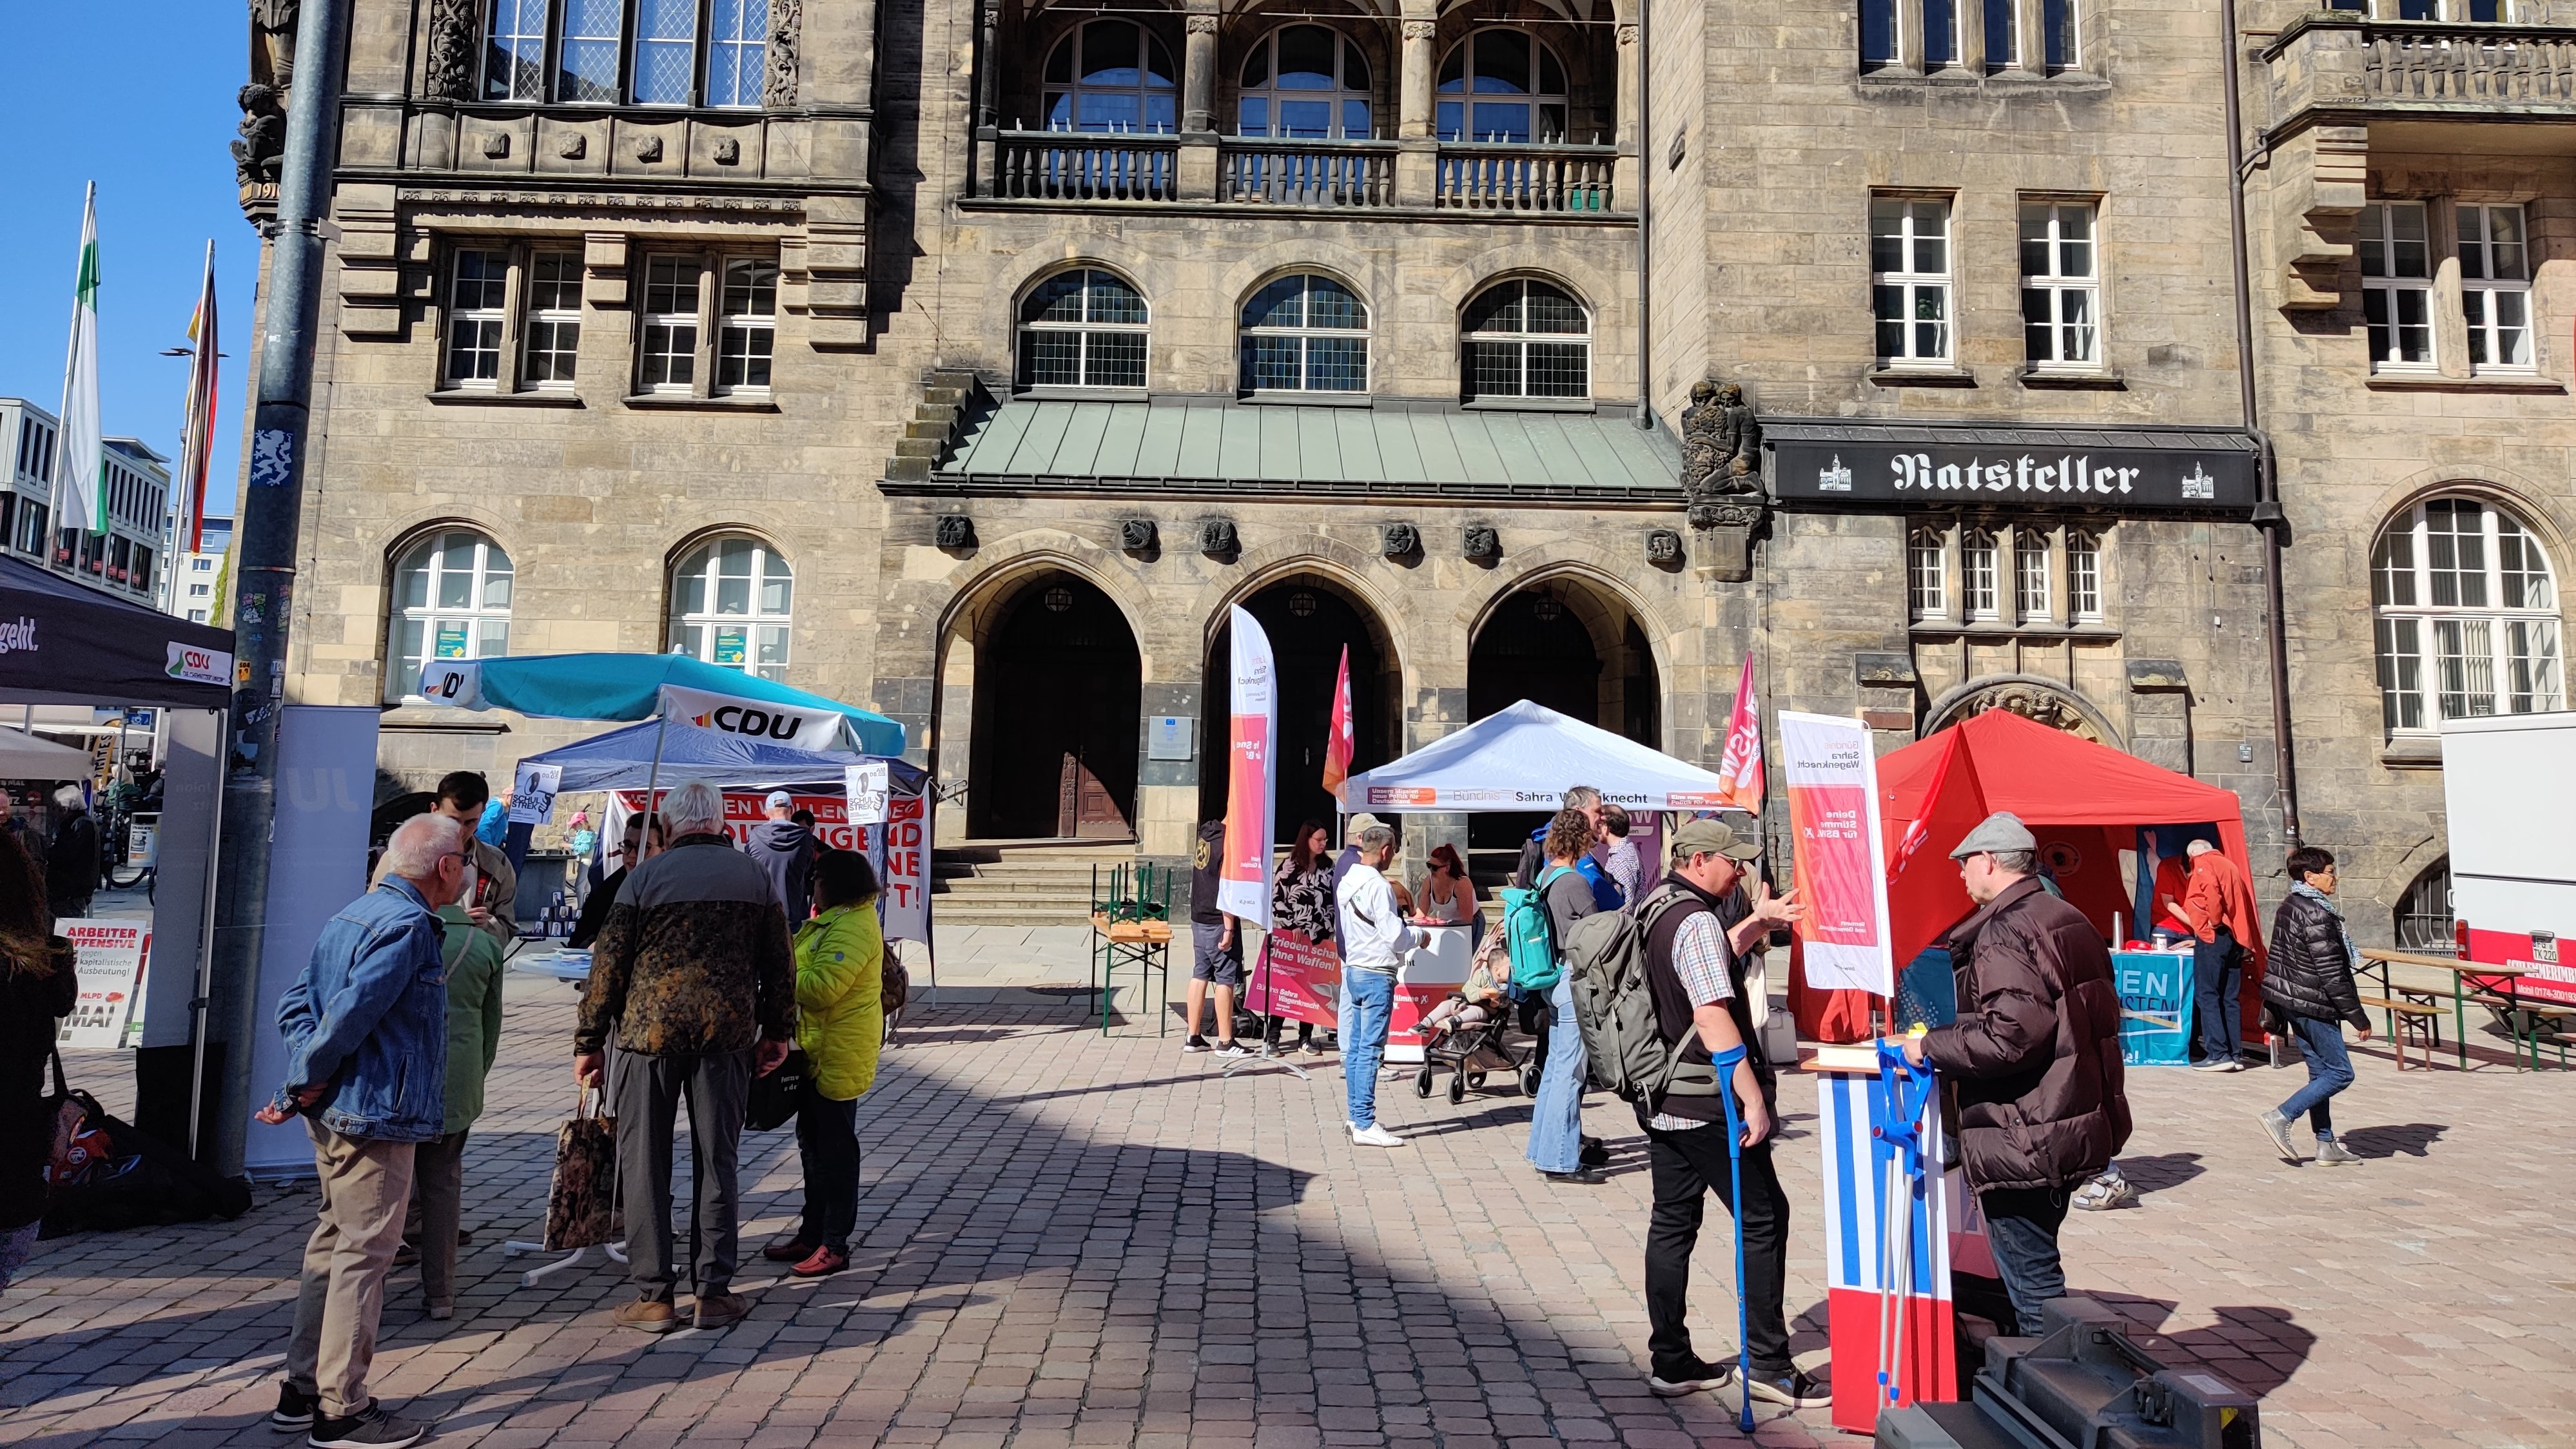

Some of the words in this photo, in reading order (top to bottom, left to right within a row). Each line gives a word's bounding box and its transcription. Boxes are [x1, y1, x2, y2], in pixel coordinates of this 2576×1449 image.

[1891, 453, 2140, 494] Ratskeller
[185, 651, 210, 670] CDU
[714, 706, 802, 739] CDU
[512, 795, 540, 804] SCHUL
[1454, 790, 1500, 801] Bündnis
[1515, 792, 1553, 802] Sahra
[67, 927, 137, 938] ARBEITER
[1271, 935, 1309, 953] Frieden
[80, 958, 132, 967] kapitalistische
[1270, 948, 1294, 961] Ohne
[1297, 954, 1335, 971] Waffen!
[78, 967, 130, 977] Ausbeutung!
[2517, 984, 2534, 995] Mobil
[64, 1005, 115, 1027] MAI
